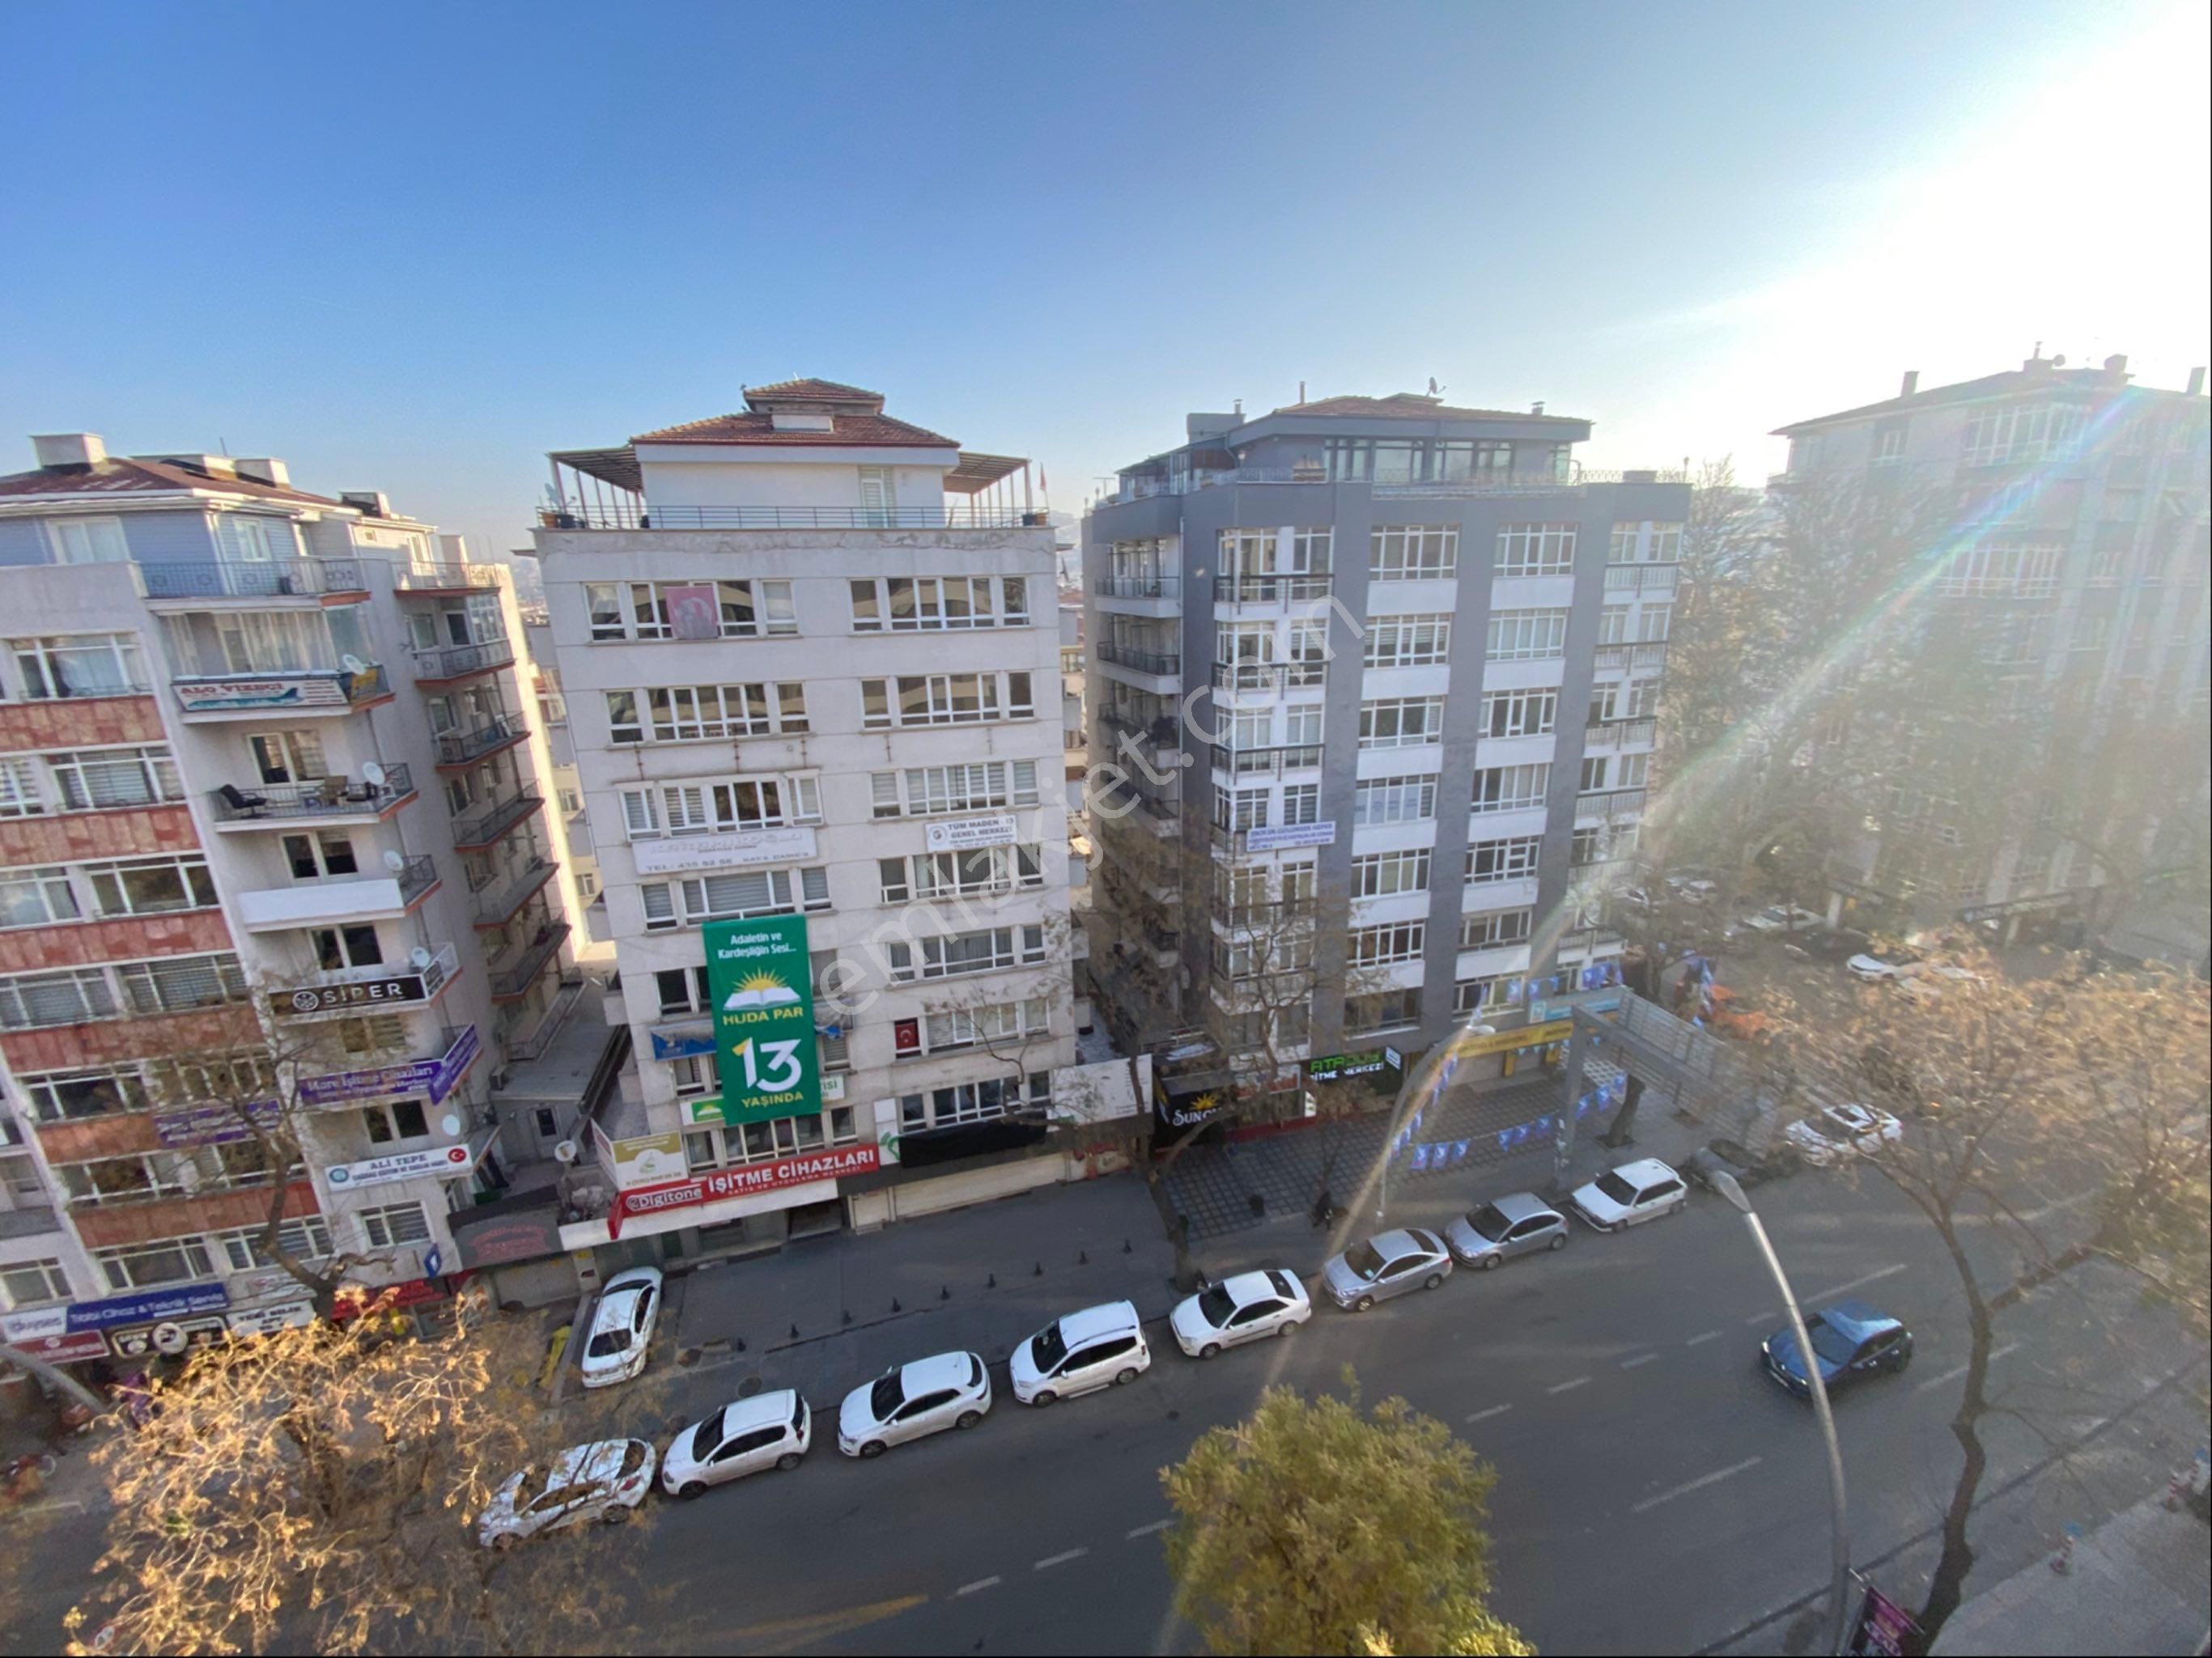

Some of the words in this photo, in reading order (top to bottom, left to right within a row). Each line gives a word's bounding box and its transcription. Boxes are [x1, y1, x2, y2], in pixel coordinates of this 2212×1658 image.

[969, 819, 1000, 828] MADEN
[731, 933, 769, 945] Adaletin
[771, 932, 782, 941] ve
[717, 945, 769, 960] Kardeşliğin
[323, 982, 404, 1004] SİPER
[773, 1006, 804, 1020] PAR
[732, 1037, 802, 1092] 13
[741, 1091, 804, 1109] YAŞINDA
[369, 1158, 391, 1170] ALİ
[396, 1154, 427, 1166] TEPE
[708, 1168, 772, 1194] İŞİTME
[777, 1149, 874, 1179] CİHAZLARI
